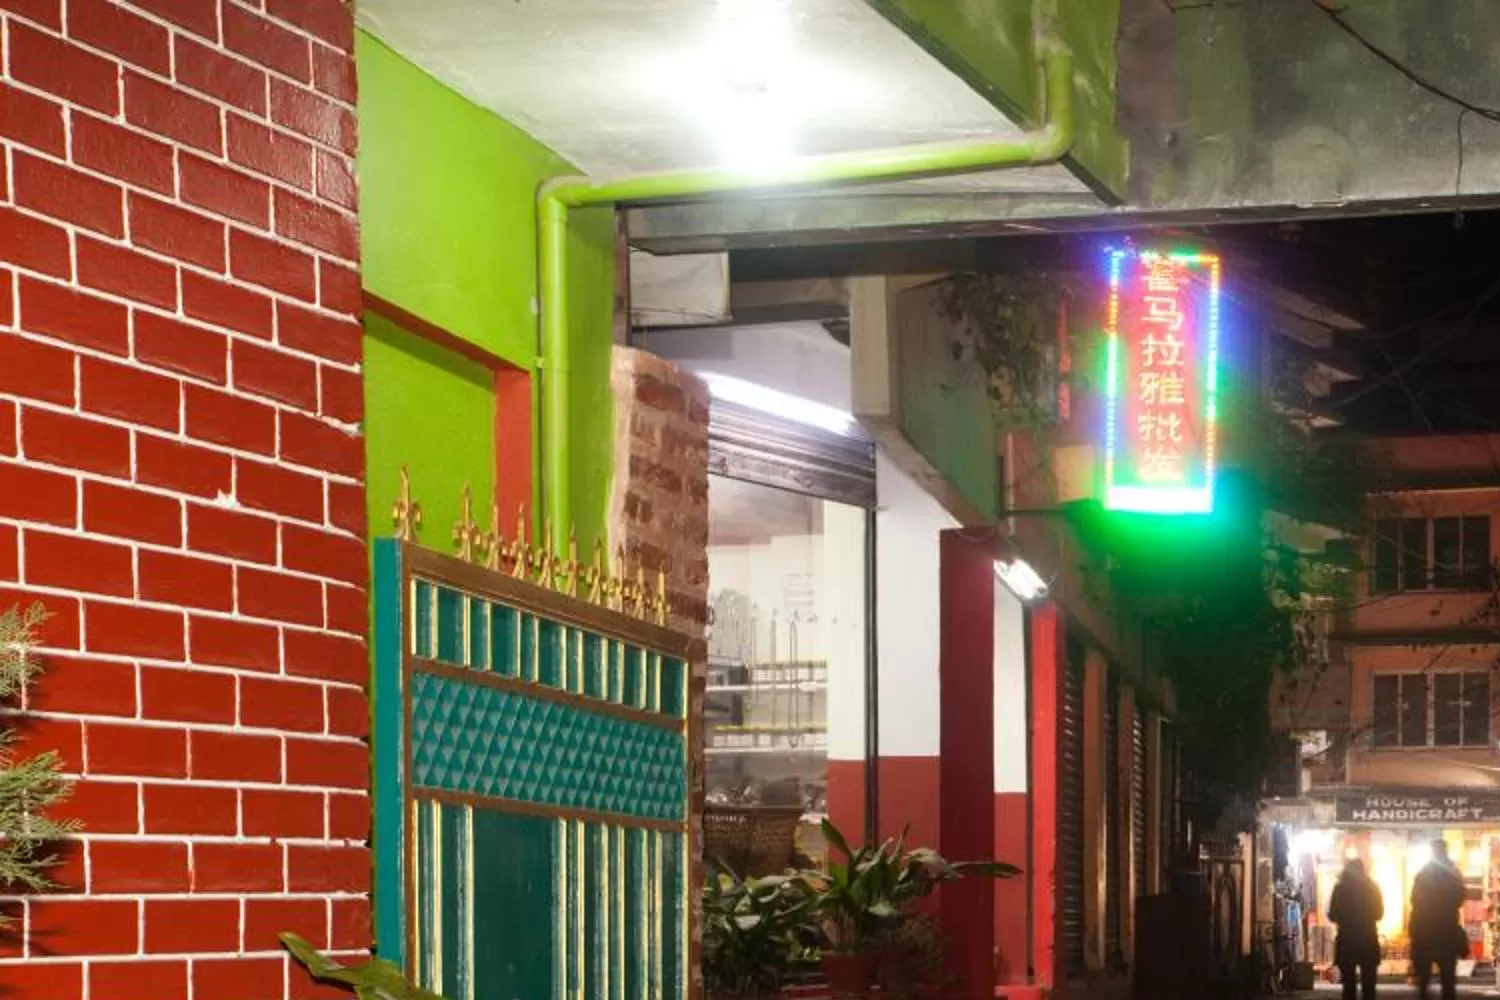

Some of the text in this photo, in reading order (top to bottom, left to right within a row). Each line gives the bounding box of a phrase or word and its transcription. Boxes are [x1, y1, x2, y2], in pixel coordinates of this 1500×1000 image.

[1366, 796, 1469, 808] HOUSE OF
[1352, 807, 1484, 821] HANDICRAFT
